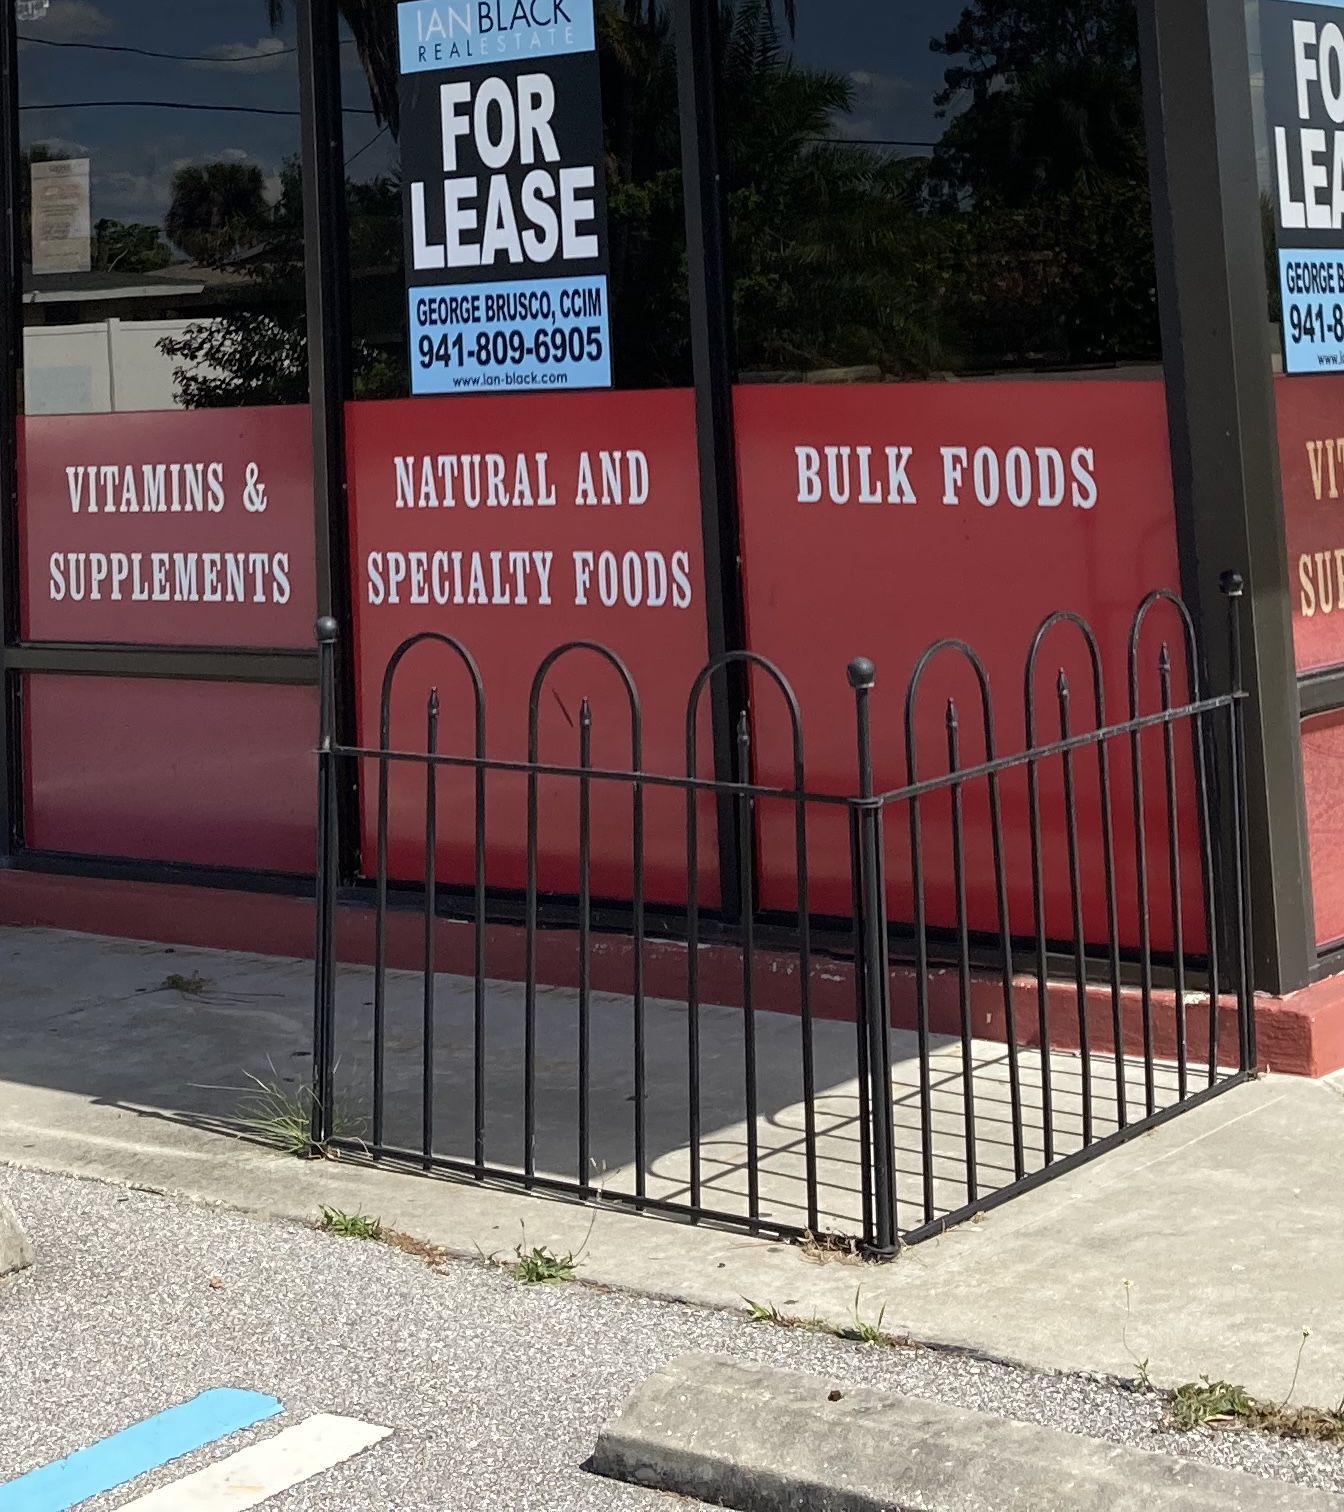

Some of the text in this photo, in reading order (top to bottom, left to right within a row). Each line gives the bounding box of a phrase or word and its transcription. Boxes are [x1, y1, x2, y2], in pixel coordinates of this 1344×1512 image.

[439, 72, 561, 172] FOR
[410, 165, 599, 270] LEASE
[1286, 261, 1335, 294] GEORGE
[416, 287, 602, 327] GEORGE BRUSCO, CCIM
[418, 326, 603, 370] 941-809-6905
[66, 462, 267, 513] VITAMINS &
[393, 449, 650, 509] NATURAL AND
[795, 445, 1099, 509] BULK FOODS
[49, 552, 291, 604] SUPPLEMENTS
[367, 549, 692, 609] SPECIALTY FOODS
